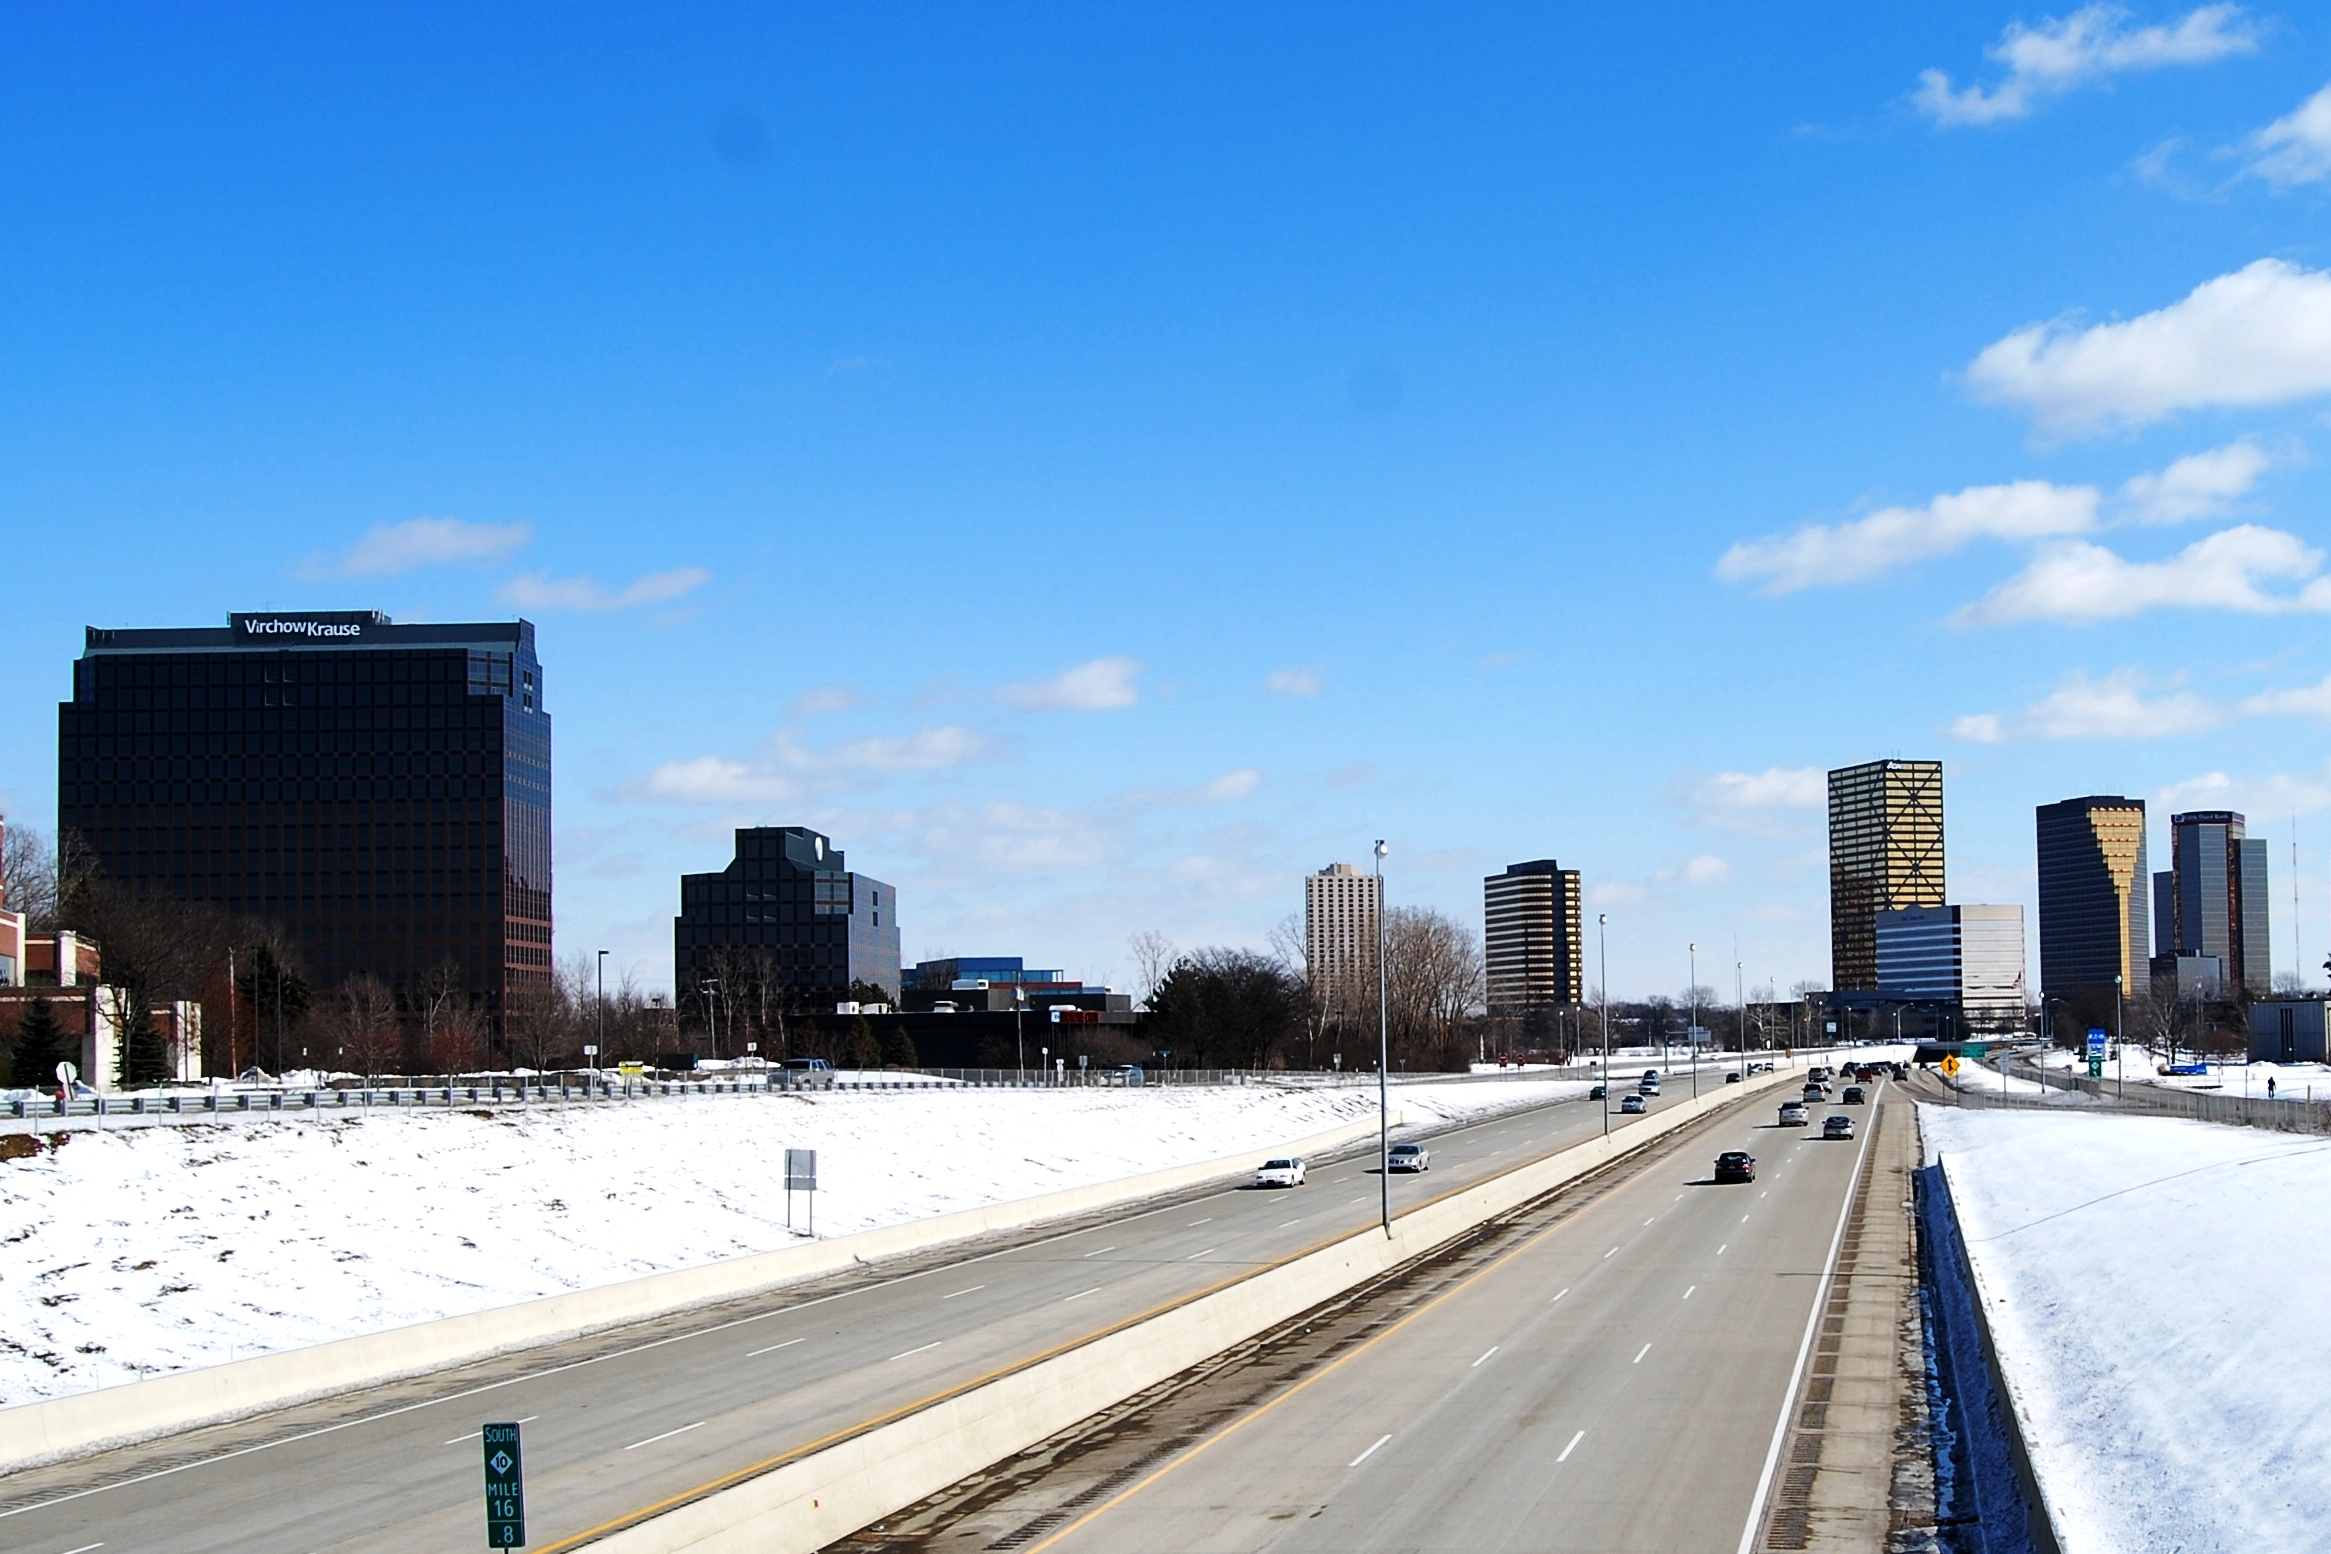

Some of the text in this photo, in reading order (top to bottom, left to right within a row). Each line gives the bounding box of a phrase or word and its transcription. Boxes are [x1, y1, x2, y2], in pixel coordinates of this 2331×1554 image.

[485, 1427, 518, 1442] SOUTH
[495, 1456, 508, 1469] 10
[487, 1482, 519, 1497] MILE
[494, 1499, 514, 1517] 16
